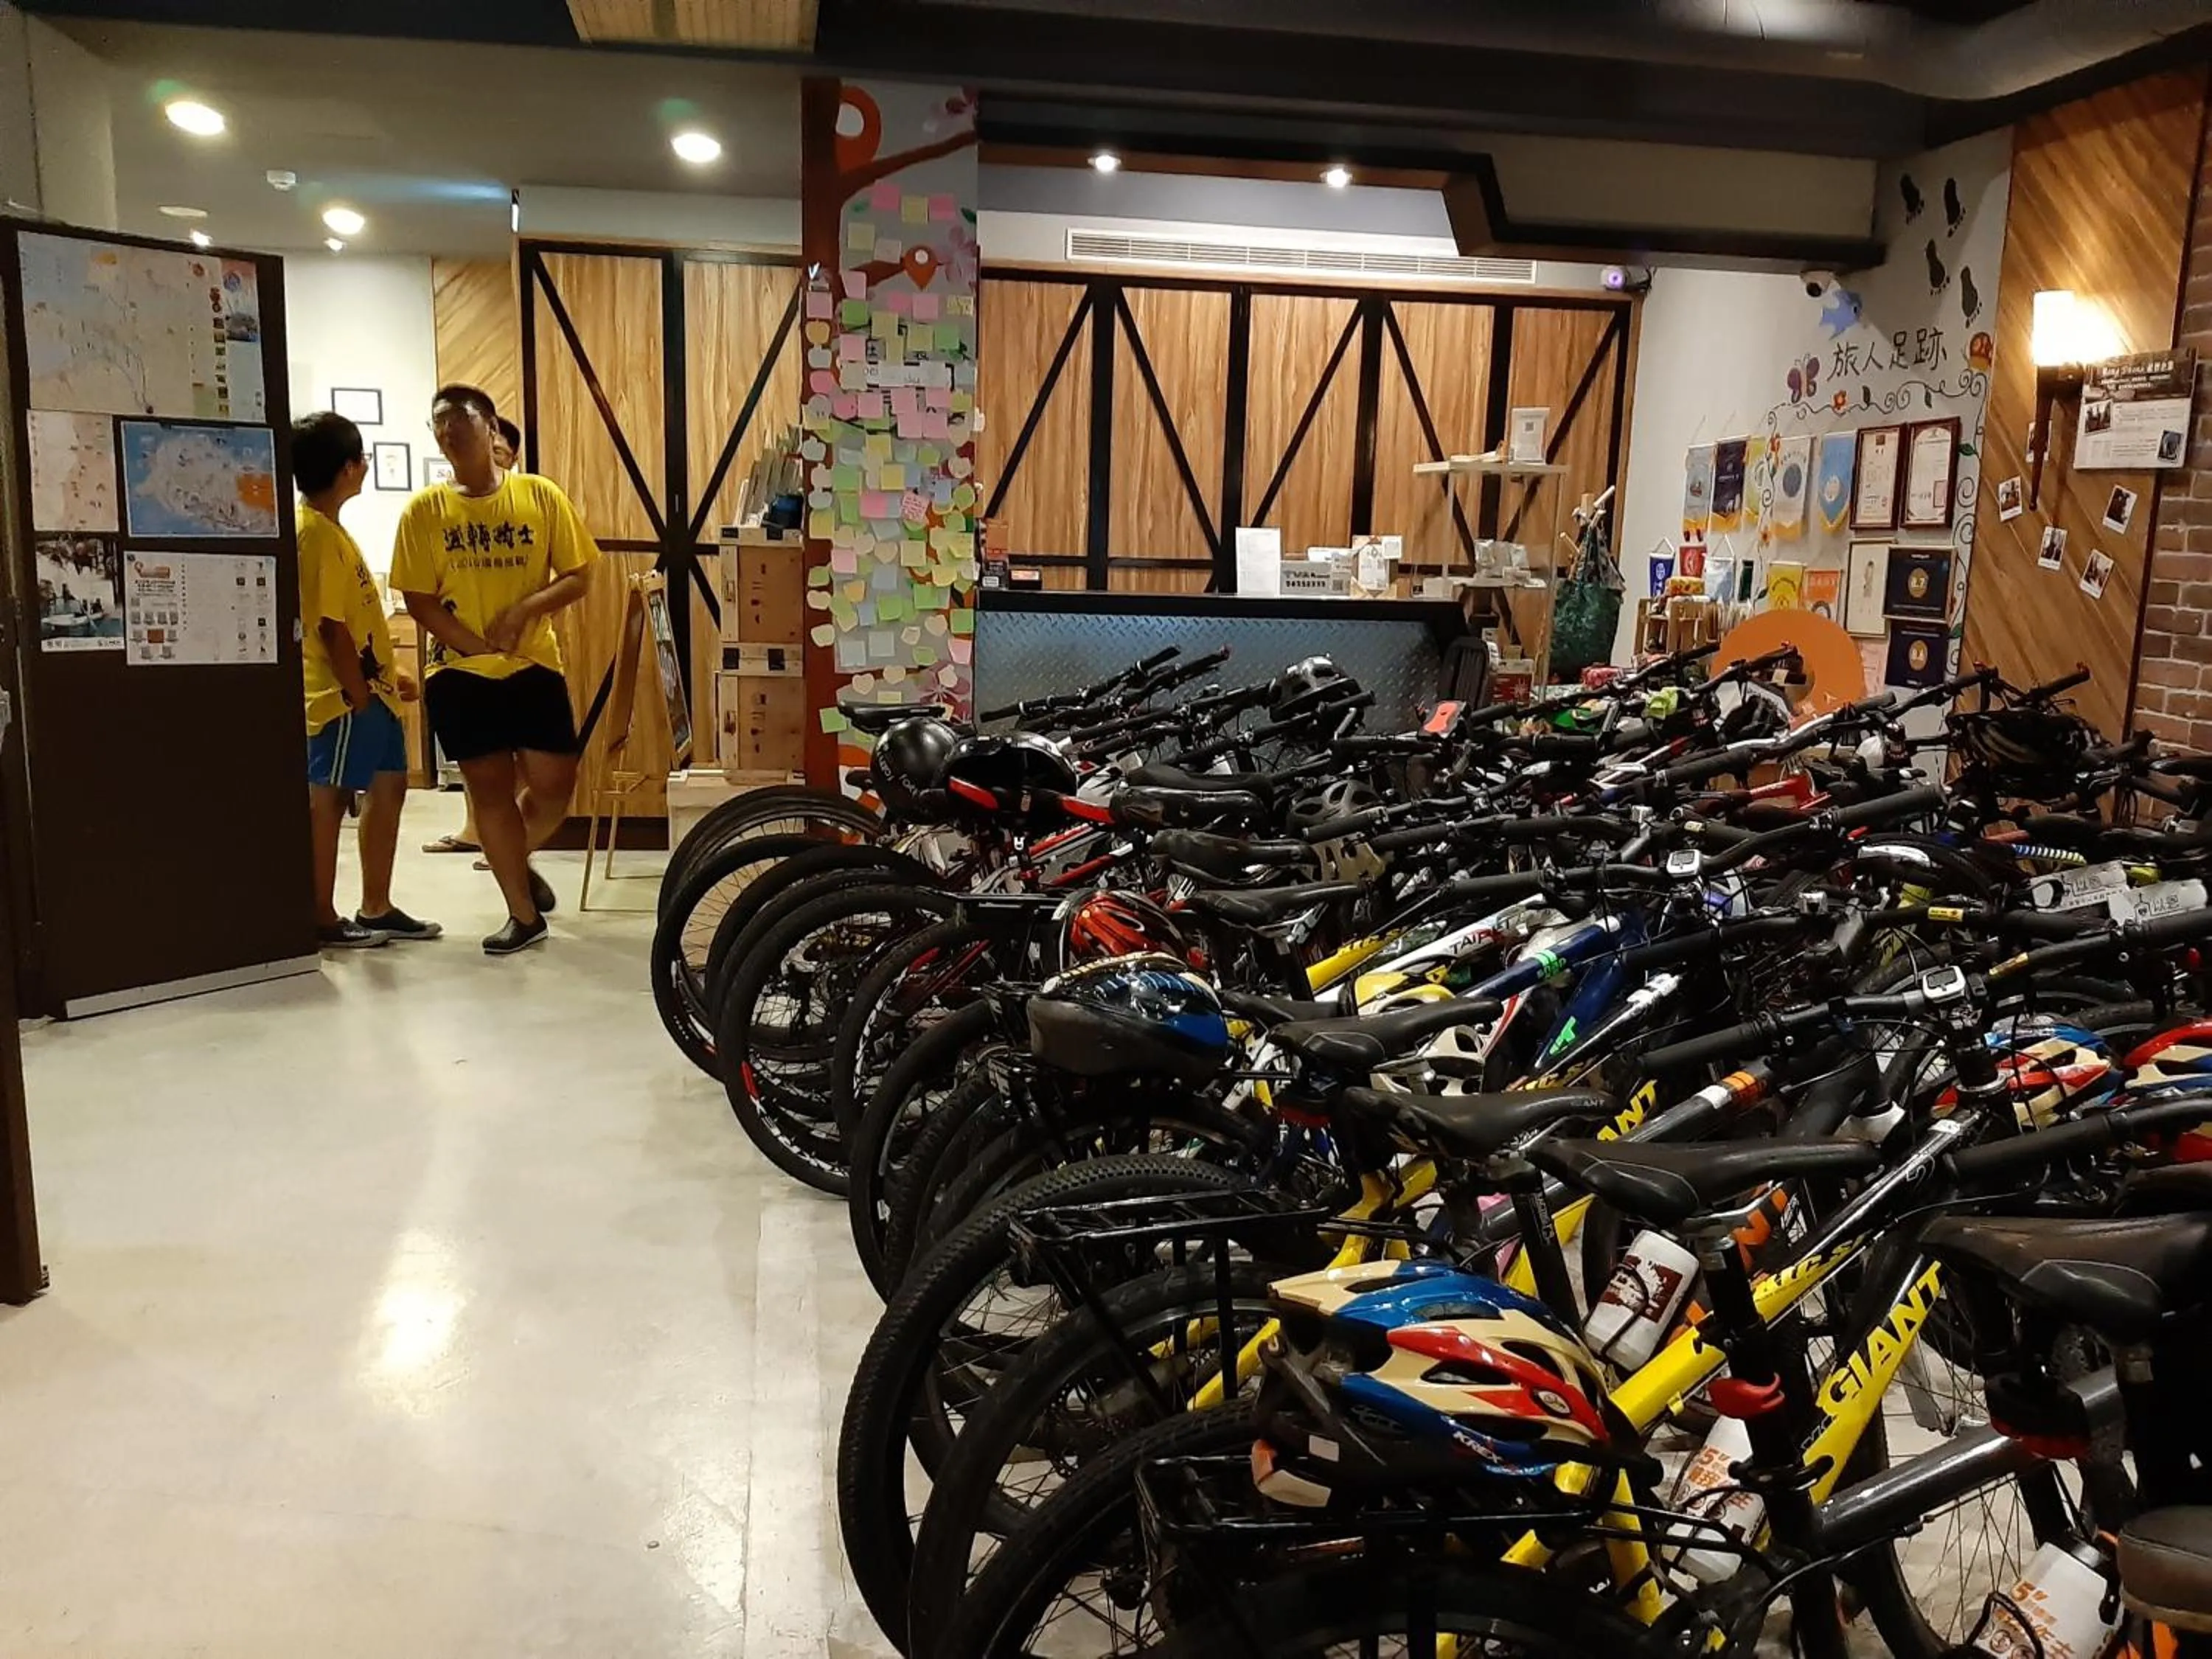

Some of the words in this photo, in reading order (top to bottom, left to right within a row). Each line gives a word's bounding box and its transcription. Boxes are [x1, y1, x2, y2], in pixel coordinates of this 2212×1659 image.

[1827, 327, 1948, 381] 旅人足跡
[1816, 1260, 1941, 1416] GIANT
